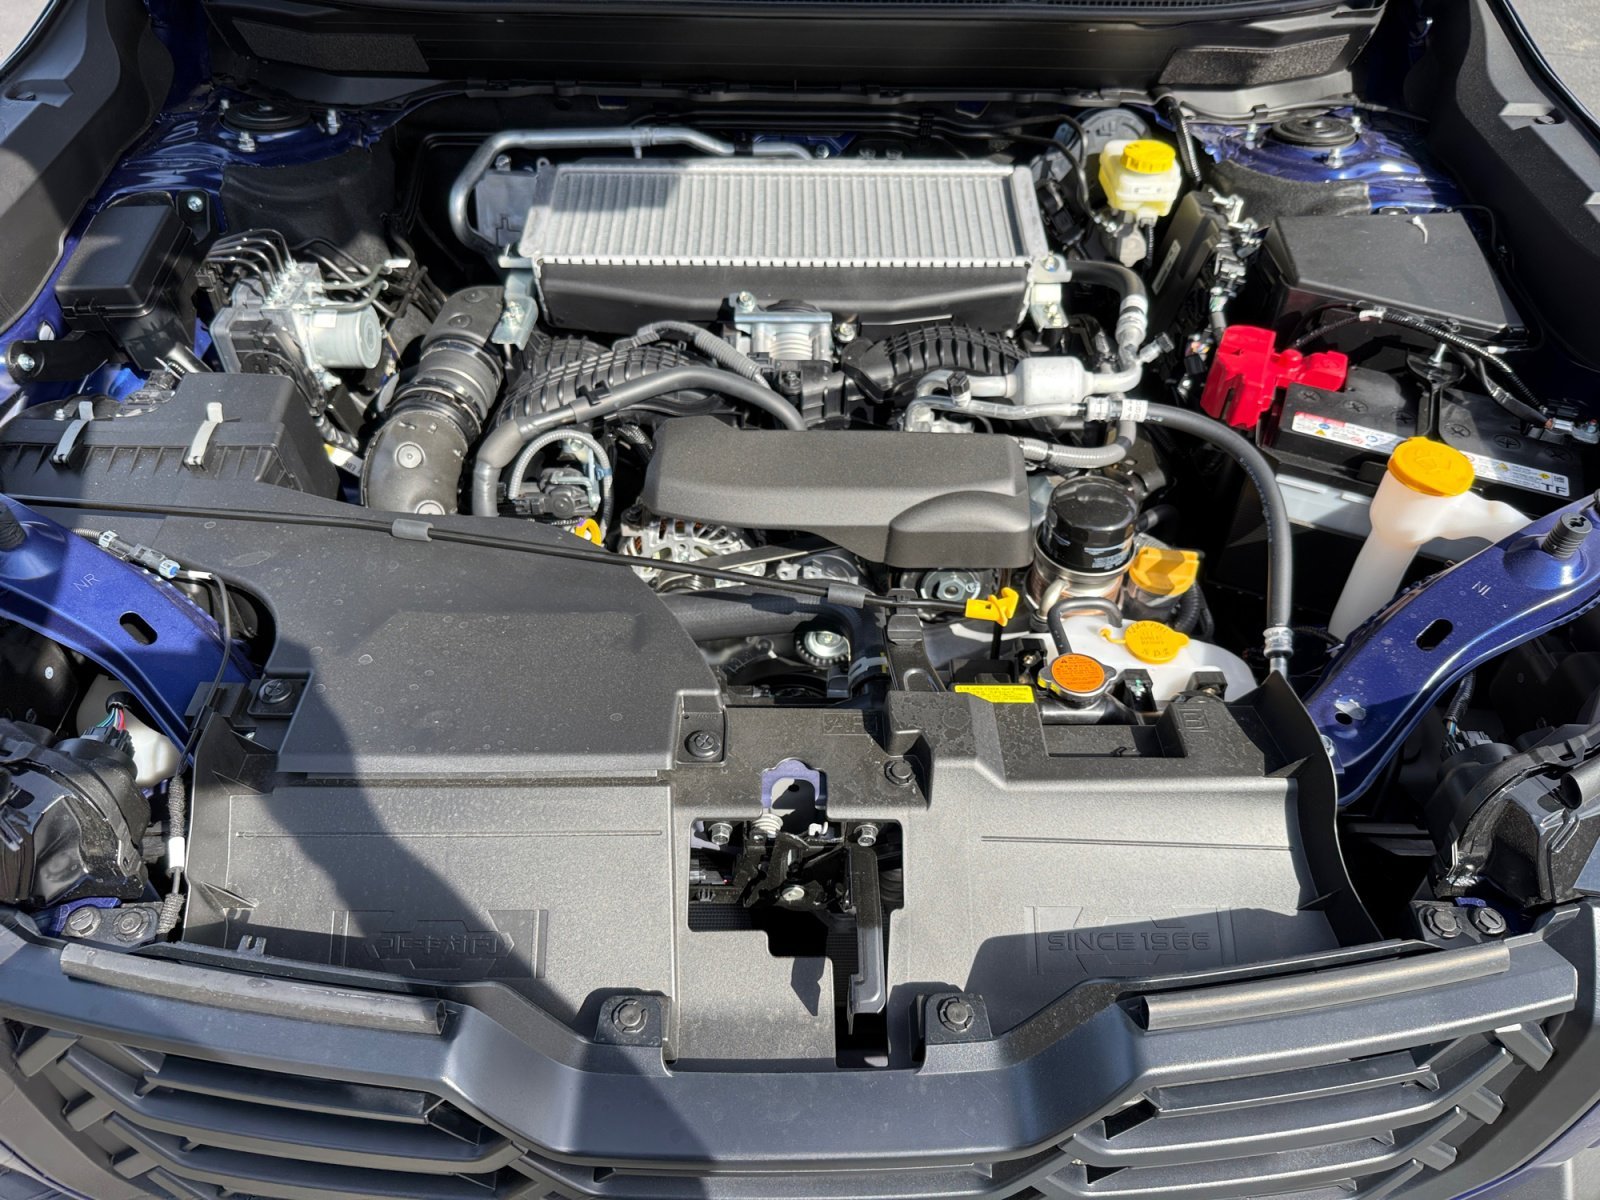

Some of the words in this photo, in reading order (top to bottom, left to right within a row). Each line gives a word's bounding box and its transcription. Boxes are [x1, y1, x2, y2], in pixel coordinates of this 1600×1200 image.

[73, 573, 99, 592] NR
[1471, 580, 1492, 600] NL
[1047, 932, 1136, 951] SINCE
[1140, 932, 1210, 951] 1966
